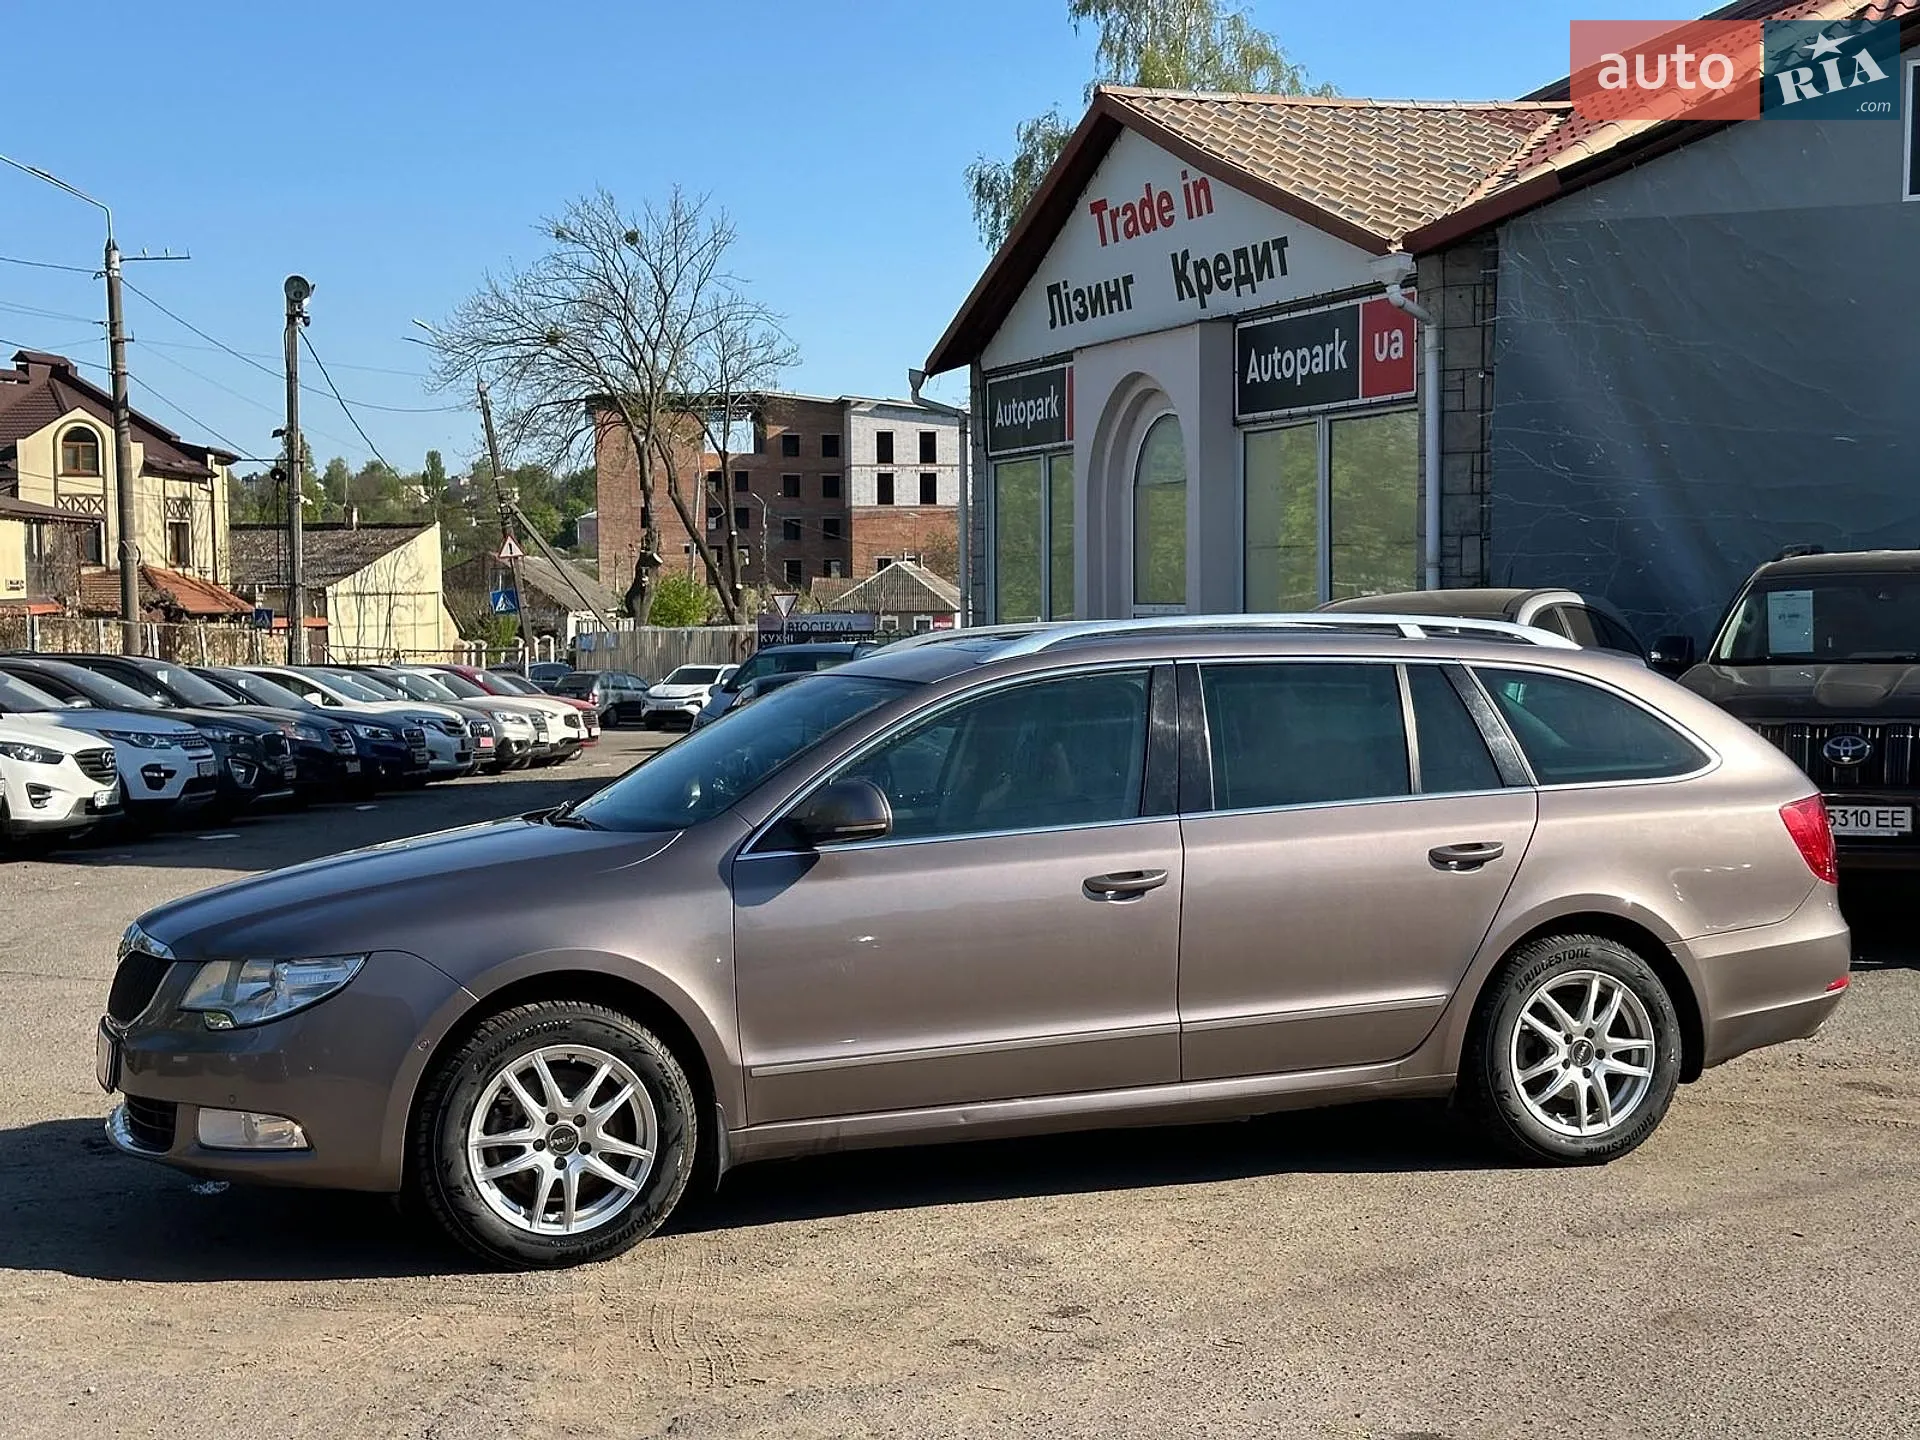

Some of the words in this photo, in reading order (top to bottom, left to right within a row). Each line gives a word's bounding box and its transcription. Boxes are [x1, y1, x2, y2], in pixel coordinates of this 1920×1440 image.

[1090, 182, 1175, 247] Trade
[1181, 170, 1213, 220] in
[1171, 236, 1290, 309] Кредит
[1047, 273, 1134, 330] Лізинг
[1245, 328, 1348, 386] Autopark
[1374, 329, 1404, 362] ua
[994, 383, 1059, 428] Autopark
[1875, 809, 1906, 828] EE
